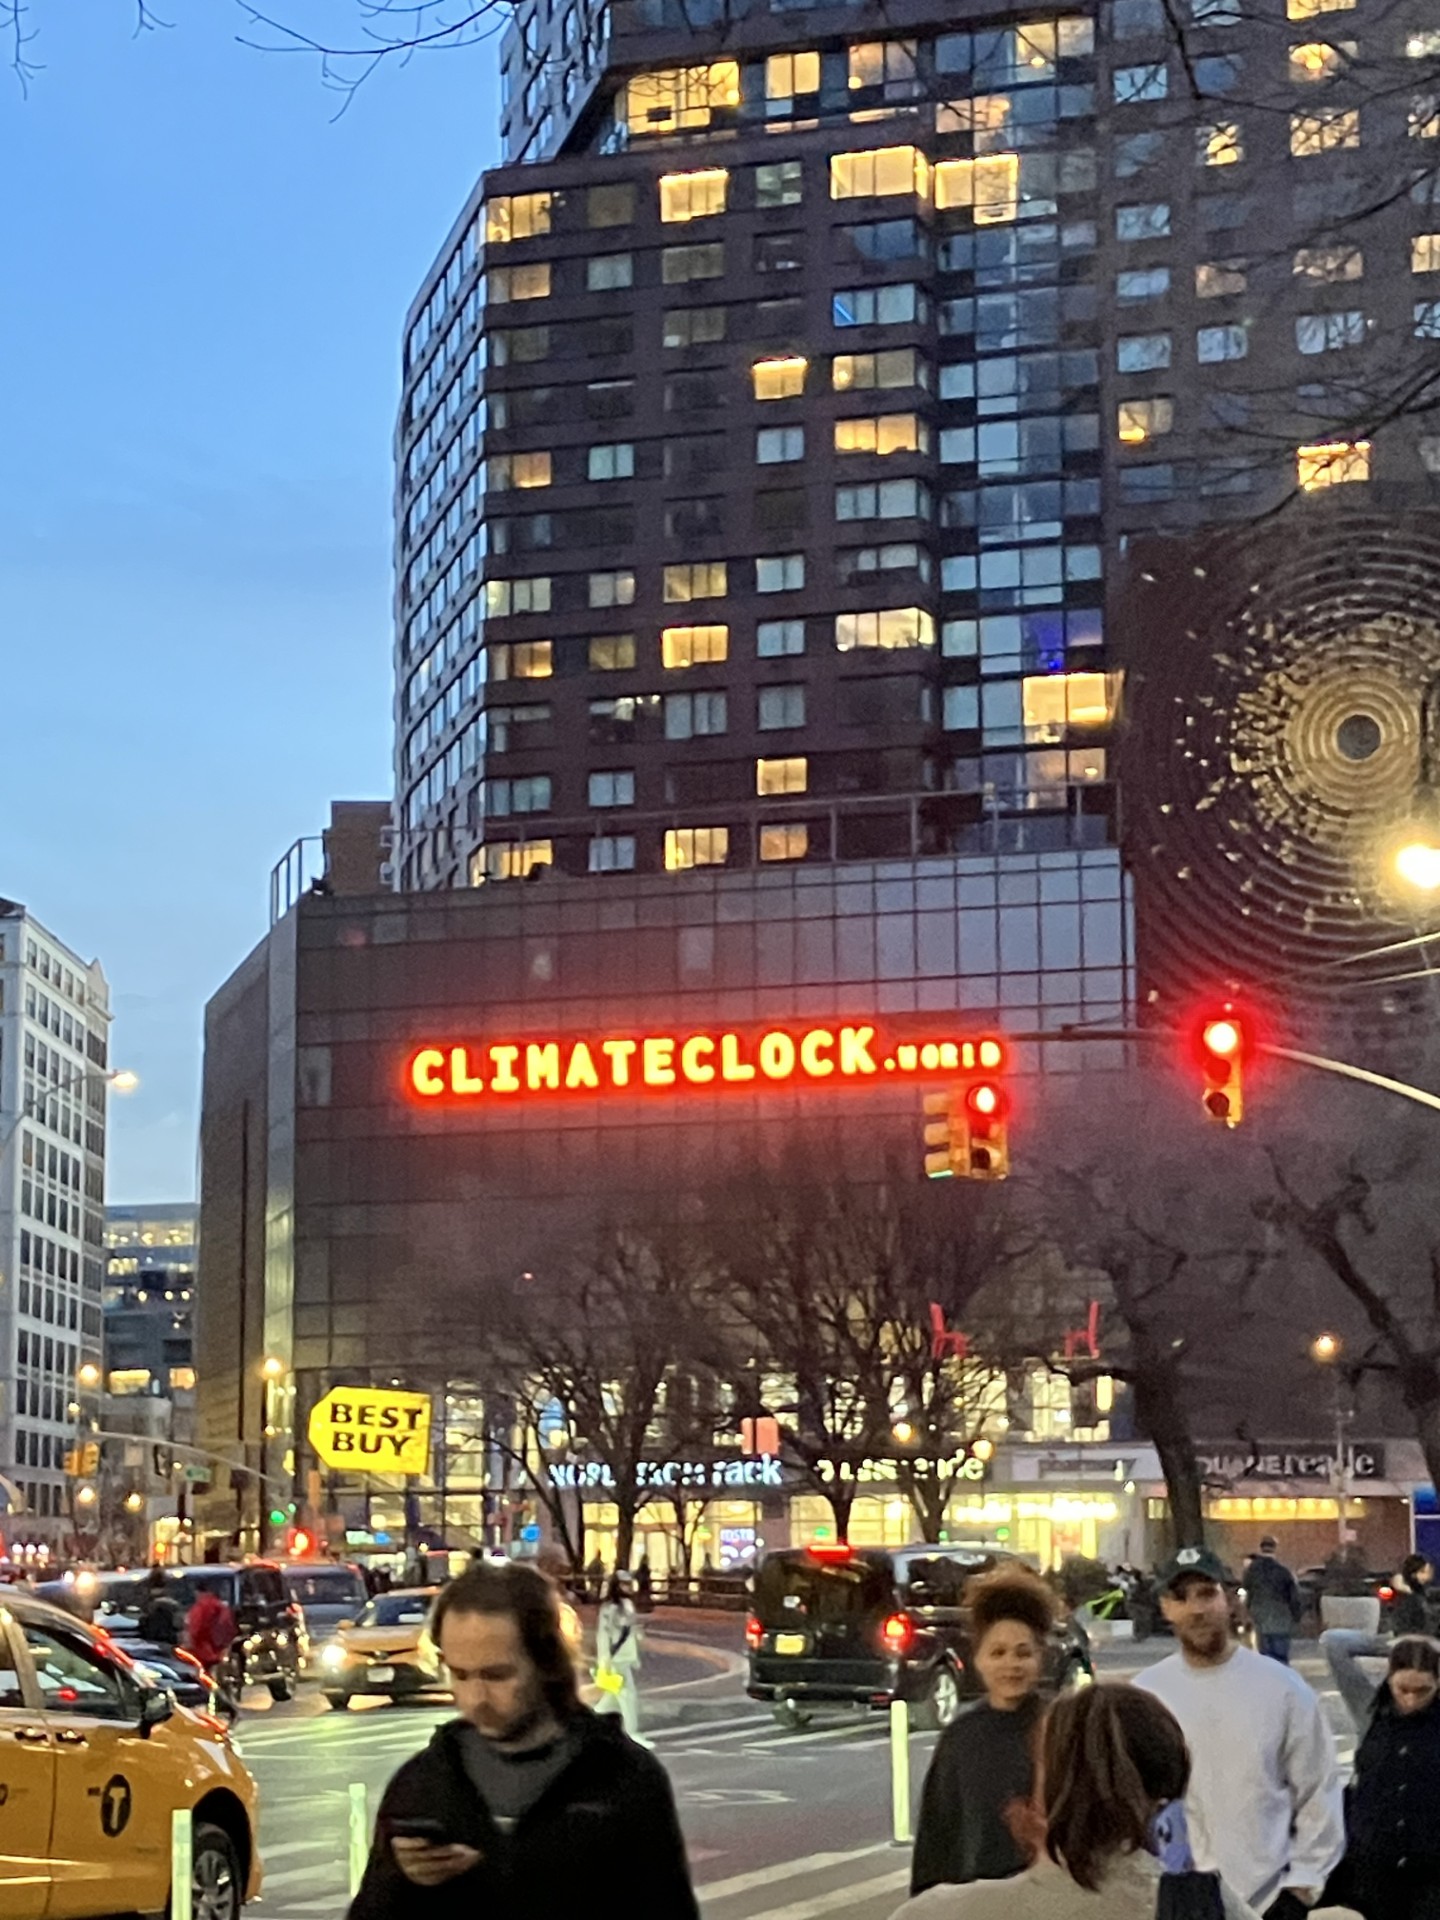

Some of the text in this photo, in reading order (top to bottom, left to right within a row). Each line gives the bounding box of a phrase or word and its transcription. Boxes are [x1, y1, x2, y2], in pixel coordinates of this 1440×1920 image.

[330, 1402, 422, 1430] BEST
[332, 1431, 412, 1457] BUY
[547, 1452, 782, 1487] NORTROM rack
